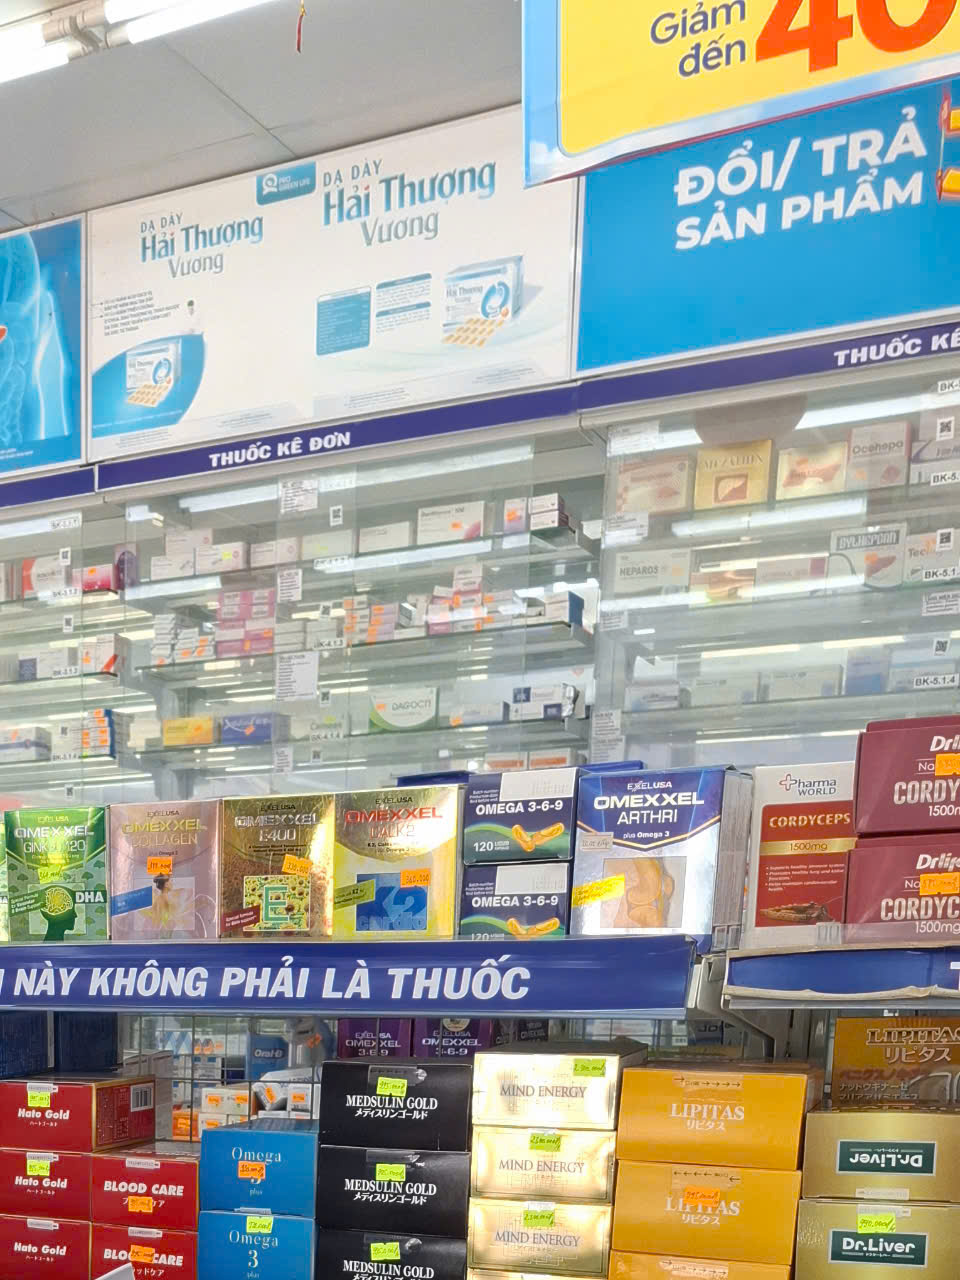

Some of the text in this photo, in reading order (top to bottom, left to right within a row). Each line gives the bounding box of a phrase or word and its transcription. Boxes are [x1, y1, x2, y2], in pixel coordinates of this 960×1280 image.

[650, 0, 746, 45] Giảm
[679, 34, 746, 77] đến
[813, 106, 926, 176] TRẢ
[323, 159, 382, 186] DẠ DÀY
[323, 161, 496, 231] Hải Thượng
[675, 169, 923, 250] SẢN PHẨM
[160, 212, 183, 229] DÀY
[361, 210, 439, 247] Vương
[141, 215, 263, 263] Hải Thượng
[168, 251, 223, 278] Vương
[834, 335, 921, 366] THUỐC
[210, 431, 351, 468] THUỐC KÊ ĐƠN
[798, 785, 837, 797] WORLD
[476, 800, 564, 816] OMEGA 3-6-9
[593, 791, 704, 810] OMEXXEL
[344, 807, 443, 824] OMEXXEL
[617, 809, 678, 826] ARTHRI
[769, 812, 851, 829] CORDYCEPS
[131, 832, 199, 847] COLLAGEN
[473, 841, 493, 852] 120
[789, 841, 828, 852] 1500mg
[75, 889, 104, 904] DHA
[471, 895, 559, 908] OMEGA 3-6-9
[14, 960, 80, 997] NÀY
[89, 959, 208, 997] KHÔNG
[220, 955, 309, 998] PHẢI
[321, 959, 370, 999] LÀ
[388, 955, 531, 1000] THUỐC
[885, 1045, 952, 1063] リピタス
[499, 1085, 588, 1099] MIND ENERGY
[346, 1094, 438, 1110] MEDSULIN GOLD
[18, 1108, 70, 1122] Hato Gold
[355, 1108, 428, 1120] メディスリンゴールド
[669, 1103, 745, 1122] LIPITAS
[686, 1119, 725, 1131] リピタス
[231, 1148, 282, 1164] Omega
[849, 1151, 923, 1167] Dr.Liver
[498, 1159, 585, 1174] MIND ENERGY
[15, 1177, 68, 1190] Hato Gold
[104, 1181, 184, 1197] BLOOD CARE
[344, 1179, 437, 1196] MEDSULIN GOLD
[353, 1192, 427, 1205] メディスリンゴールド
[495, 1231, 581, 1248] MIND ENERGY
[841, 1237, 915, 1254] Dr.Liver
[13, 1243, 67, 1257] Hato Gold
[153, 1255, 184, 1266] CARE
[343, 1260, 434, 1279] MEDSULIN GOLD
